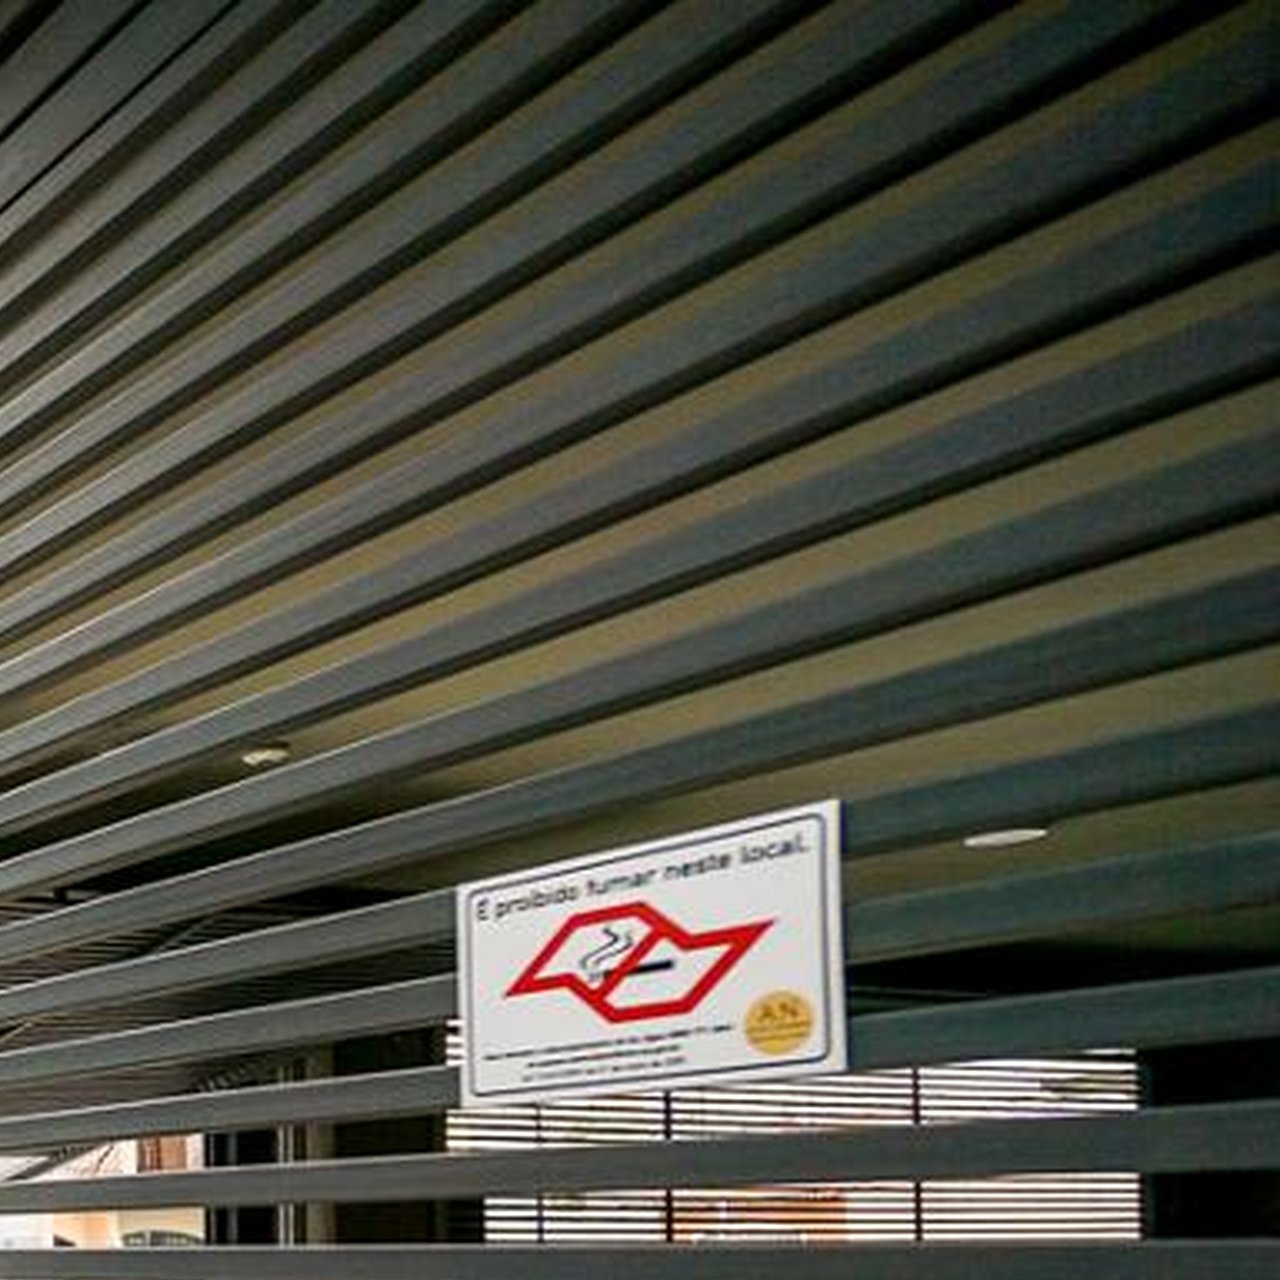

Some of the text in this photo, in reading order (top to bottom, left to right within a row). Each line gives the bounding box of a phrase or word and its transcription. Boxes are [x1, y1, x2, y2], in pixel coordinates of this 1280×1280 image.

[494, 886, 580, 920] proibido
[586, 868, 657, 897] fumar
[663, 853, 731, 880] neste
